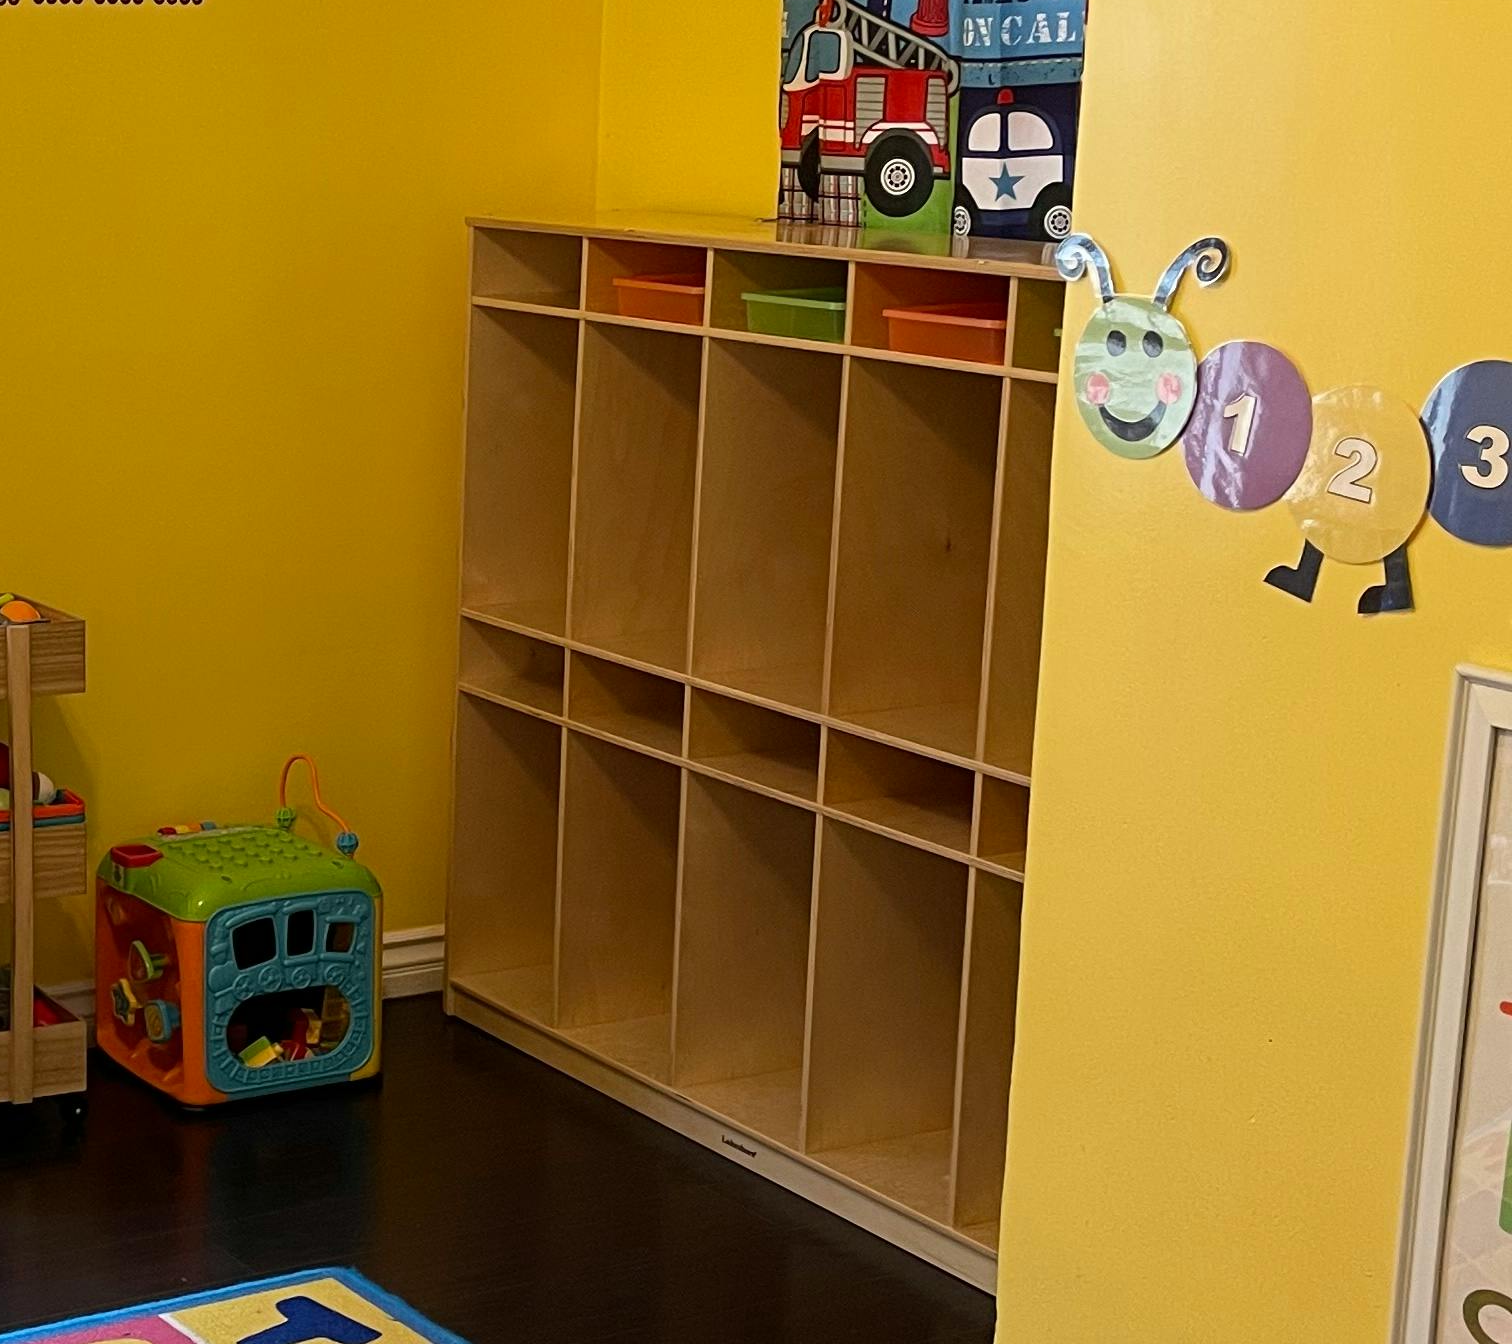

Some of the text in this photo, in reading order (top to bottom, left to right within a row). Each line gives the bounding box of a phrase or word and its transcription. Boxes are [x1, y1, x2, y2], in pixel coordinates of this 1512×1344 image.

[1001, 11, 1088, 46] CAL
[1223, 392, 1510, 504] 1 2 3
